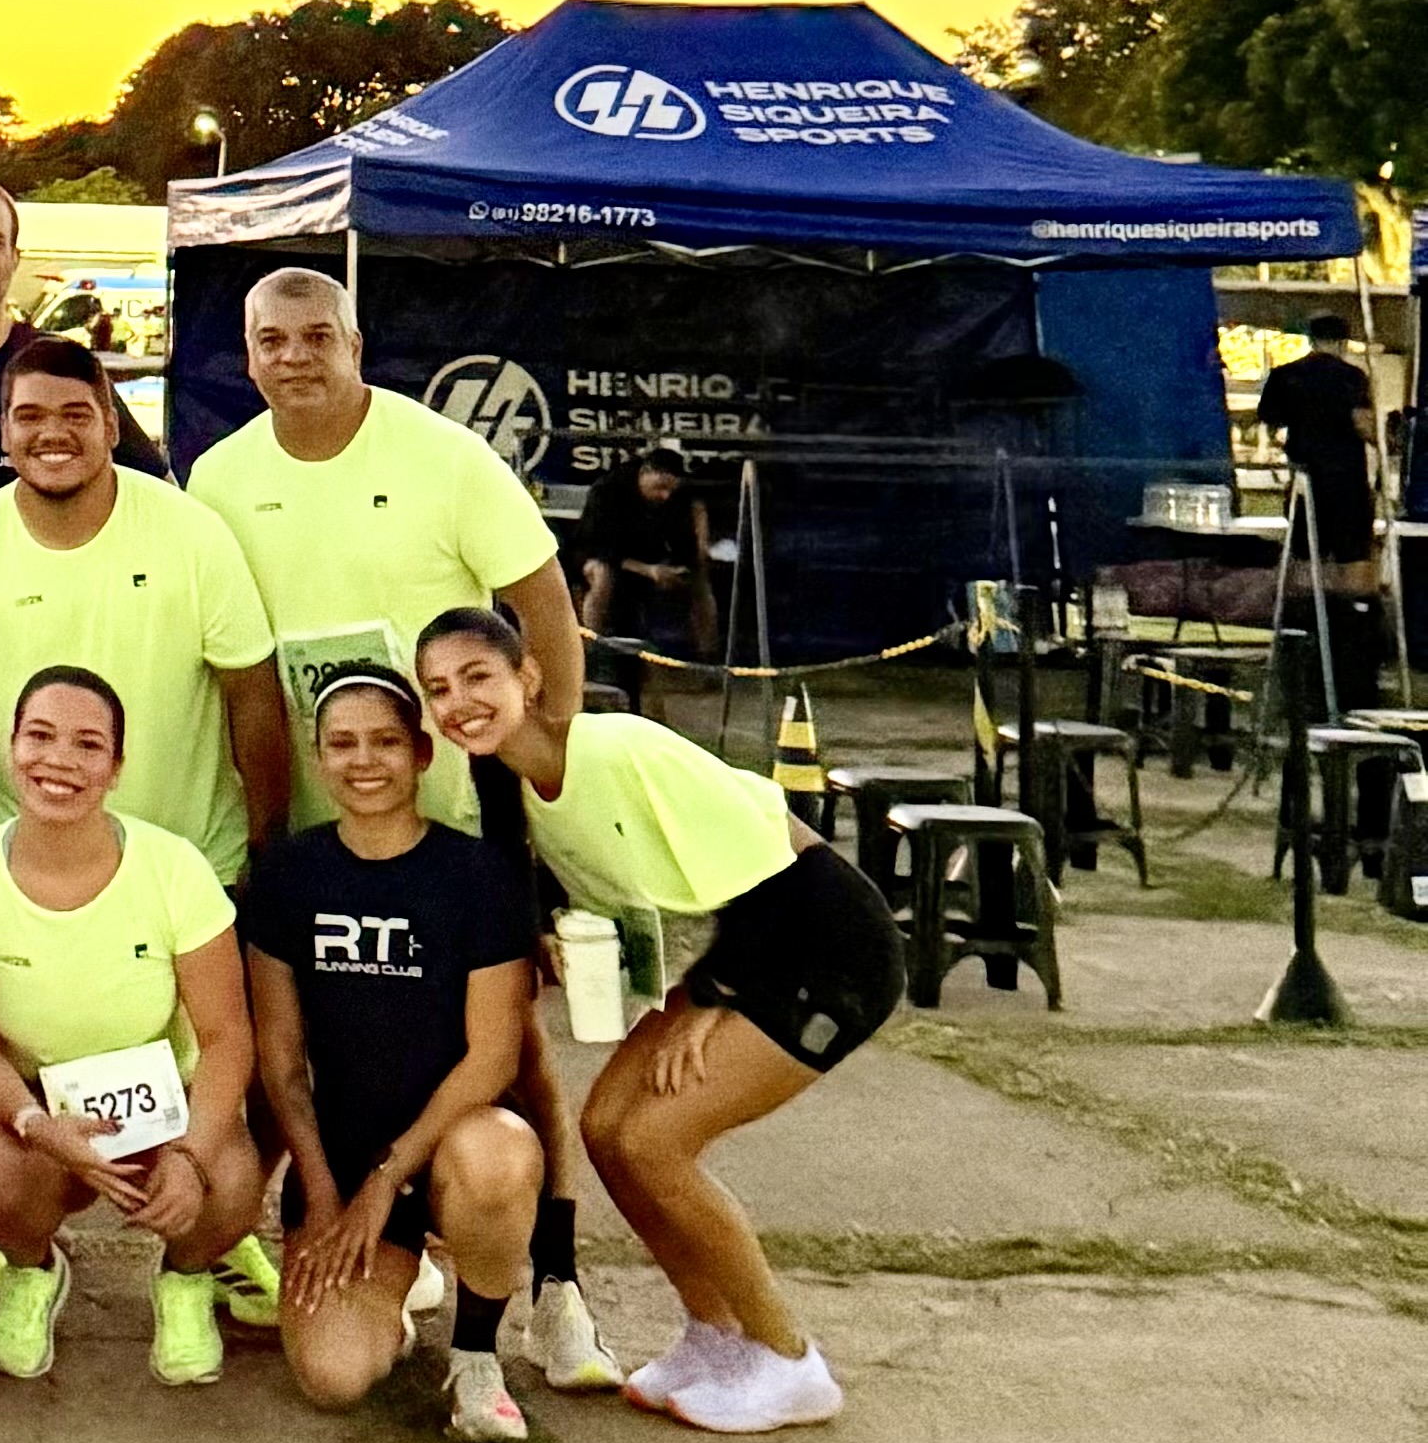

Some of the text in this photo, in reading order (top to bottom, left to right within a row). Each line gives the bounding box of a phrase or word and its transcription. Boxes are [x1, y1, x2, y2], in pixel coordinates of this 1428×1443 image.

[704, 79, 955, 105] HENRIQUE
[722, 104, 950, 126] SIQUEIRA
[737, 125, 936, 145] SPORTS
[521, 203, 656, 227] 98216-1773
[1031, 218, 1320, 242] @henriquesiqueirasports
[315, 961, 423, 977] RUNNING CLUB
[83, 1083, 157, 1121] 5273
